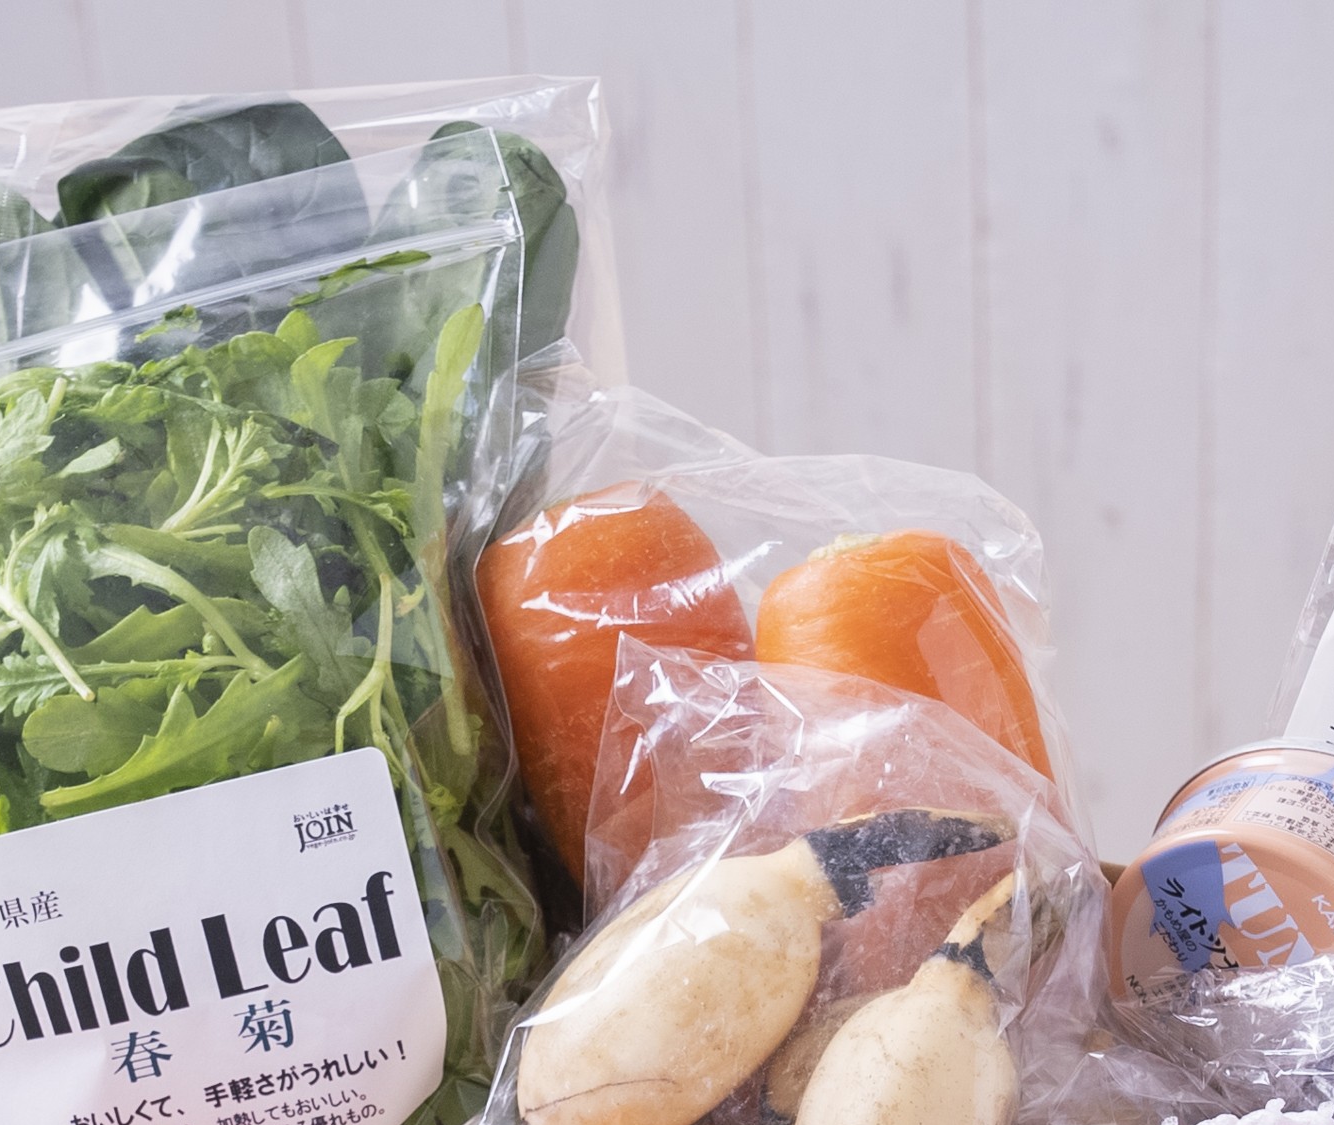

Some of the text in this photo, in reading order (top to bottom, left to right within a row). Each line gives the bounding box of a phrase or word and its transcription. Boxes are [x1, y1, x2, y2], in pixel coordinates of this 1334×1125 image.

[293, 811, 354, 853] JOIN
[201, 870, 402, 999] Leaf
[1151, 917, 1191, 967] こだわり
[1152, 895, 1199, 954] かもめ屋の
[110, 998, 296, 1084] 春 菊
